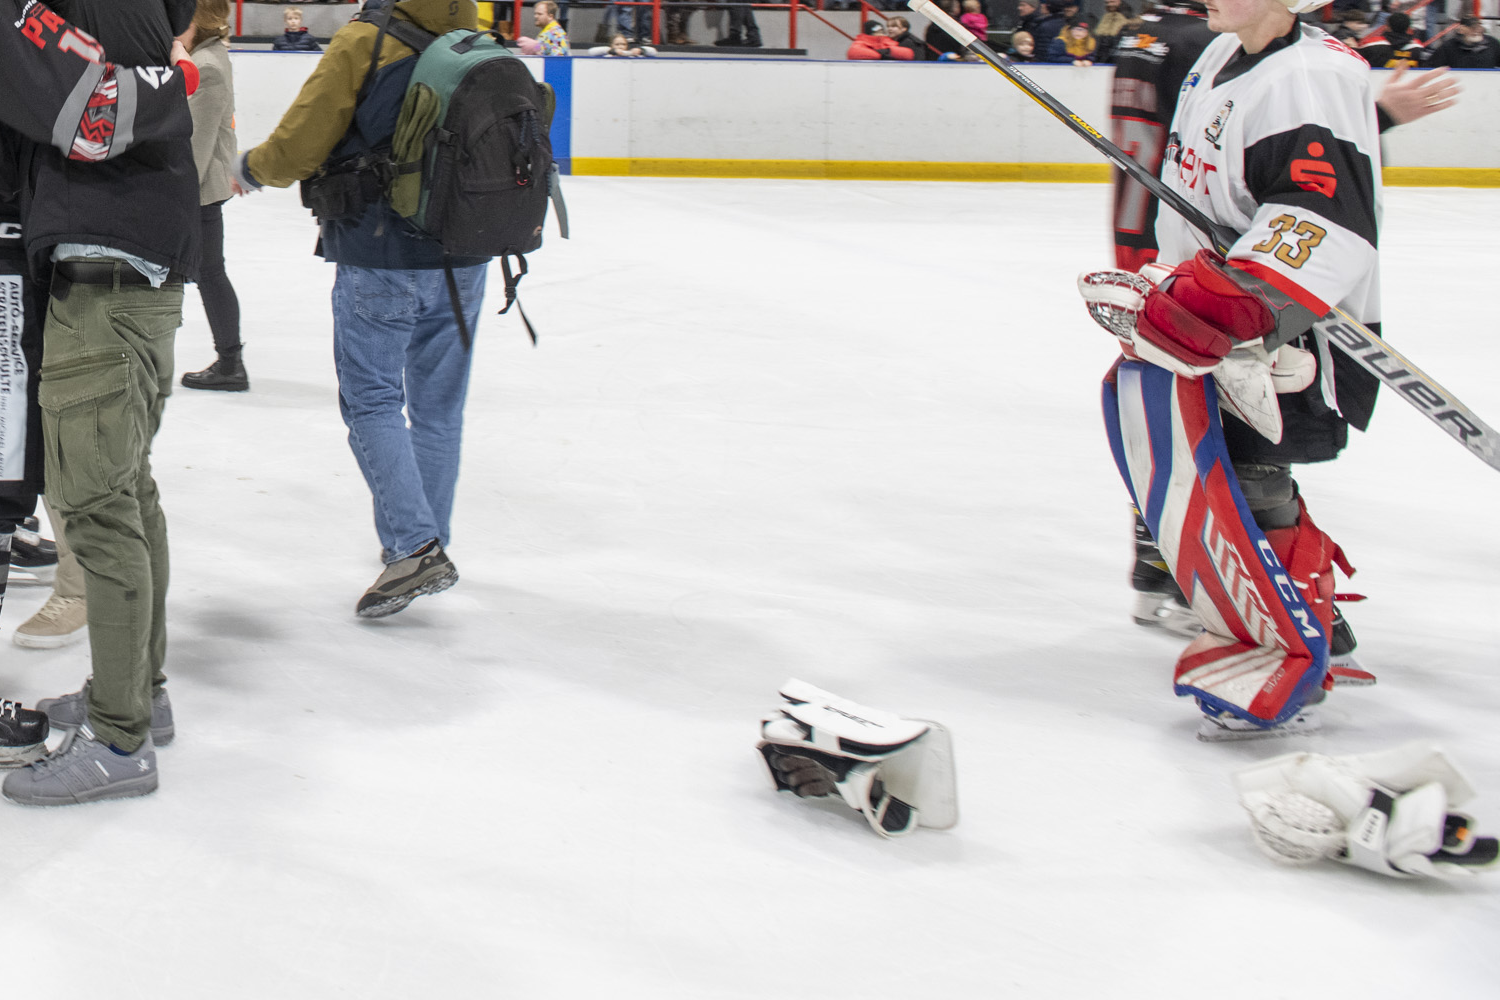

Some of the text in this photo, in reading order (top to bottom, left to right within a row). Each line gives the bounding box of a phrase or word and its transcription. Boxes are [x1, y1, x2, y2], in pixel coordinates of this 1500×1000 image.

[1068, 113, 1103, 140] MACH
[1251, 213, 1328, 270] 33
[1257, 538, 1322, 639] CCM
